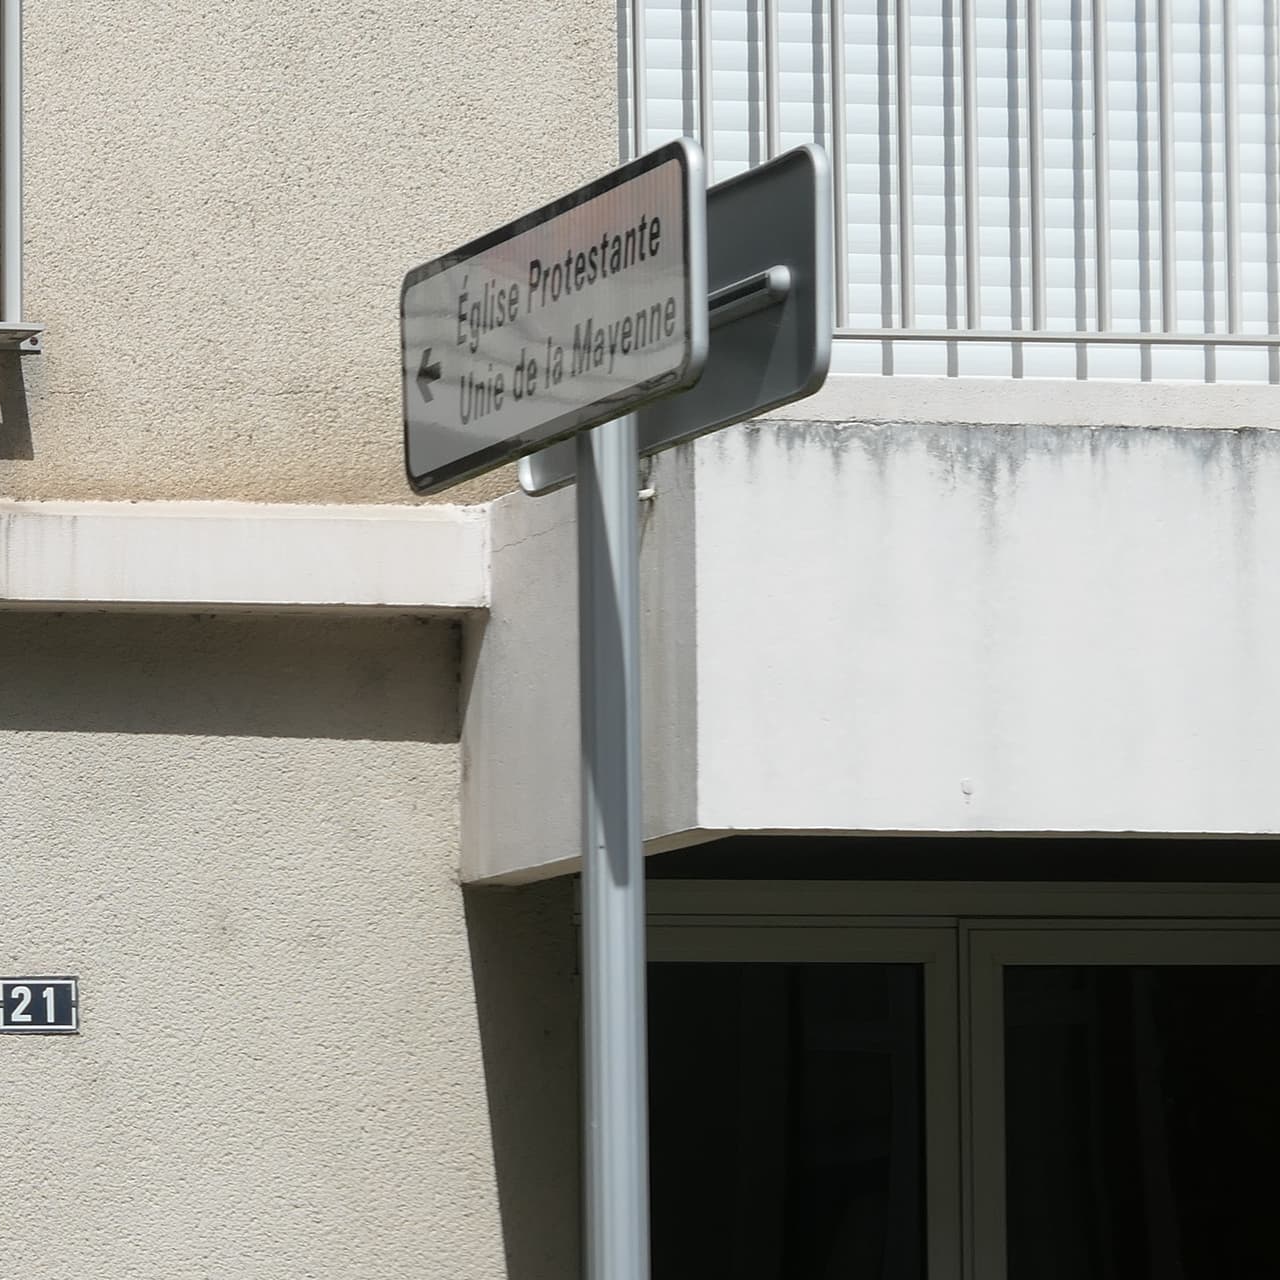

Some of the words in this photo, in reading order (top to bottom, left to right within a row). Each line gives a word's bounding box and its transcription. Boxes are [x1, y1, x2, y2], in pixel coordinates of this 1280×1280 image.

[457, 275, 519, 354] Église
[527, 215, 661, 314] Protestante
[459, 364, 503, 425] Unie
[513, 348, 537, 402] de
[543, 335, 564, 390] la
[570, 296, 676, 375] Mayenne
[11, 986, 55, 1023] 21
